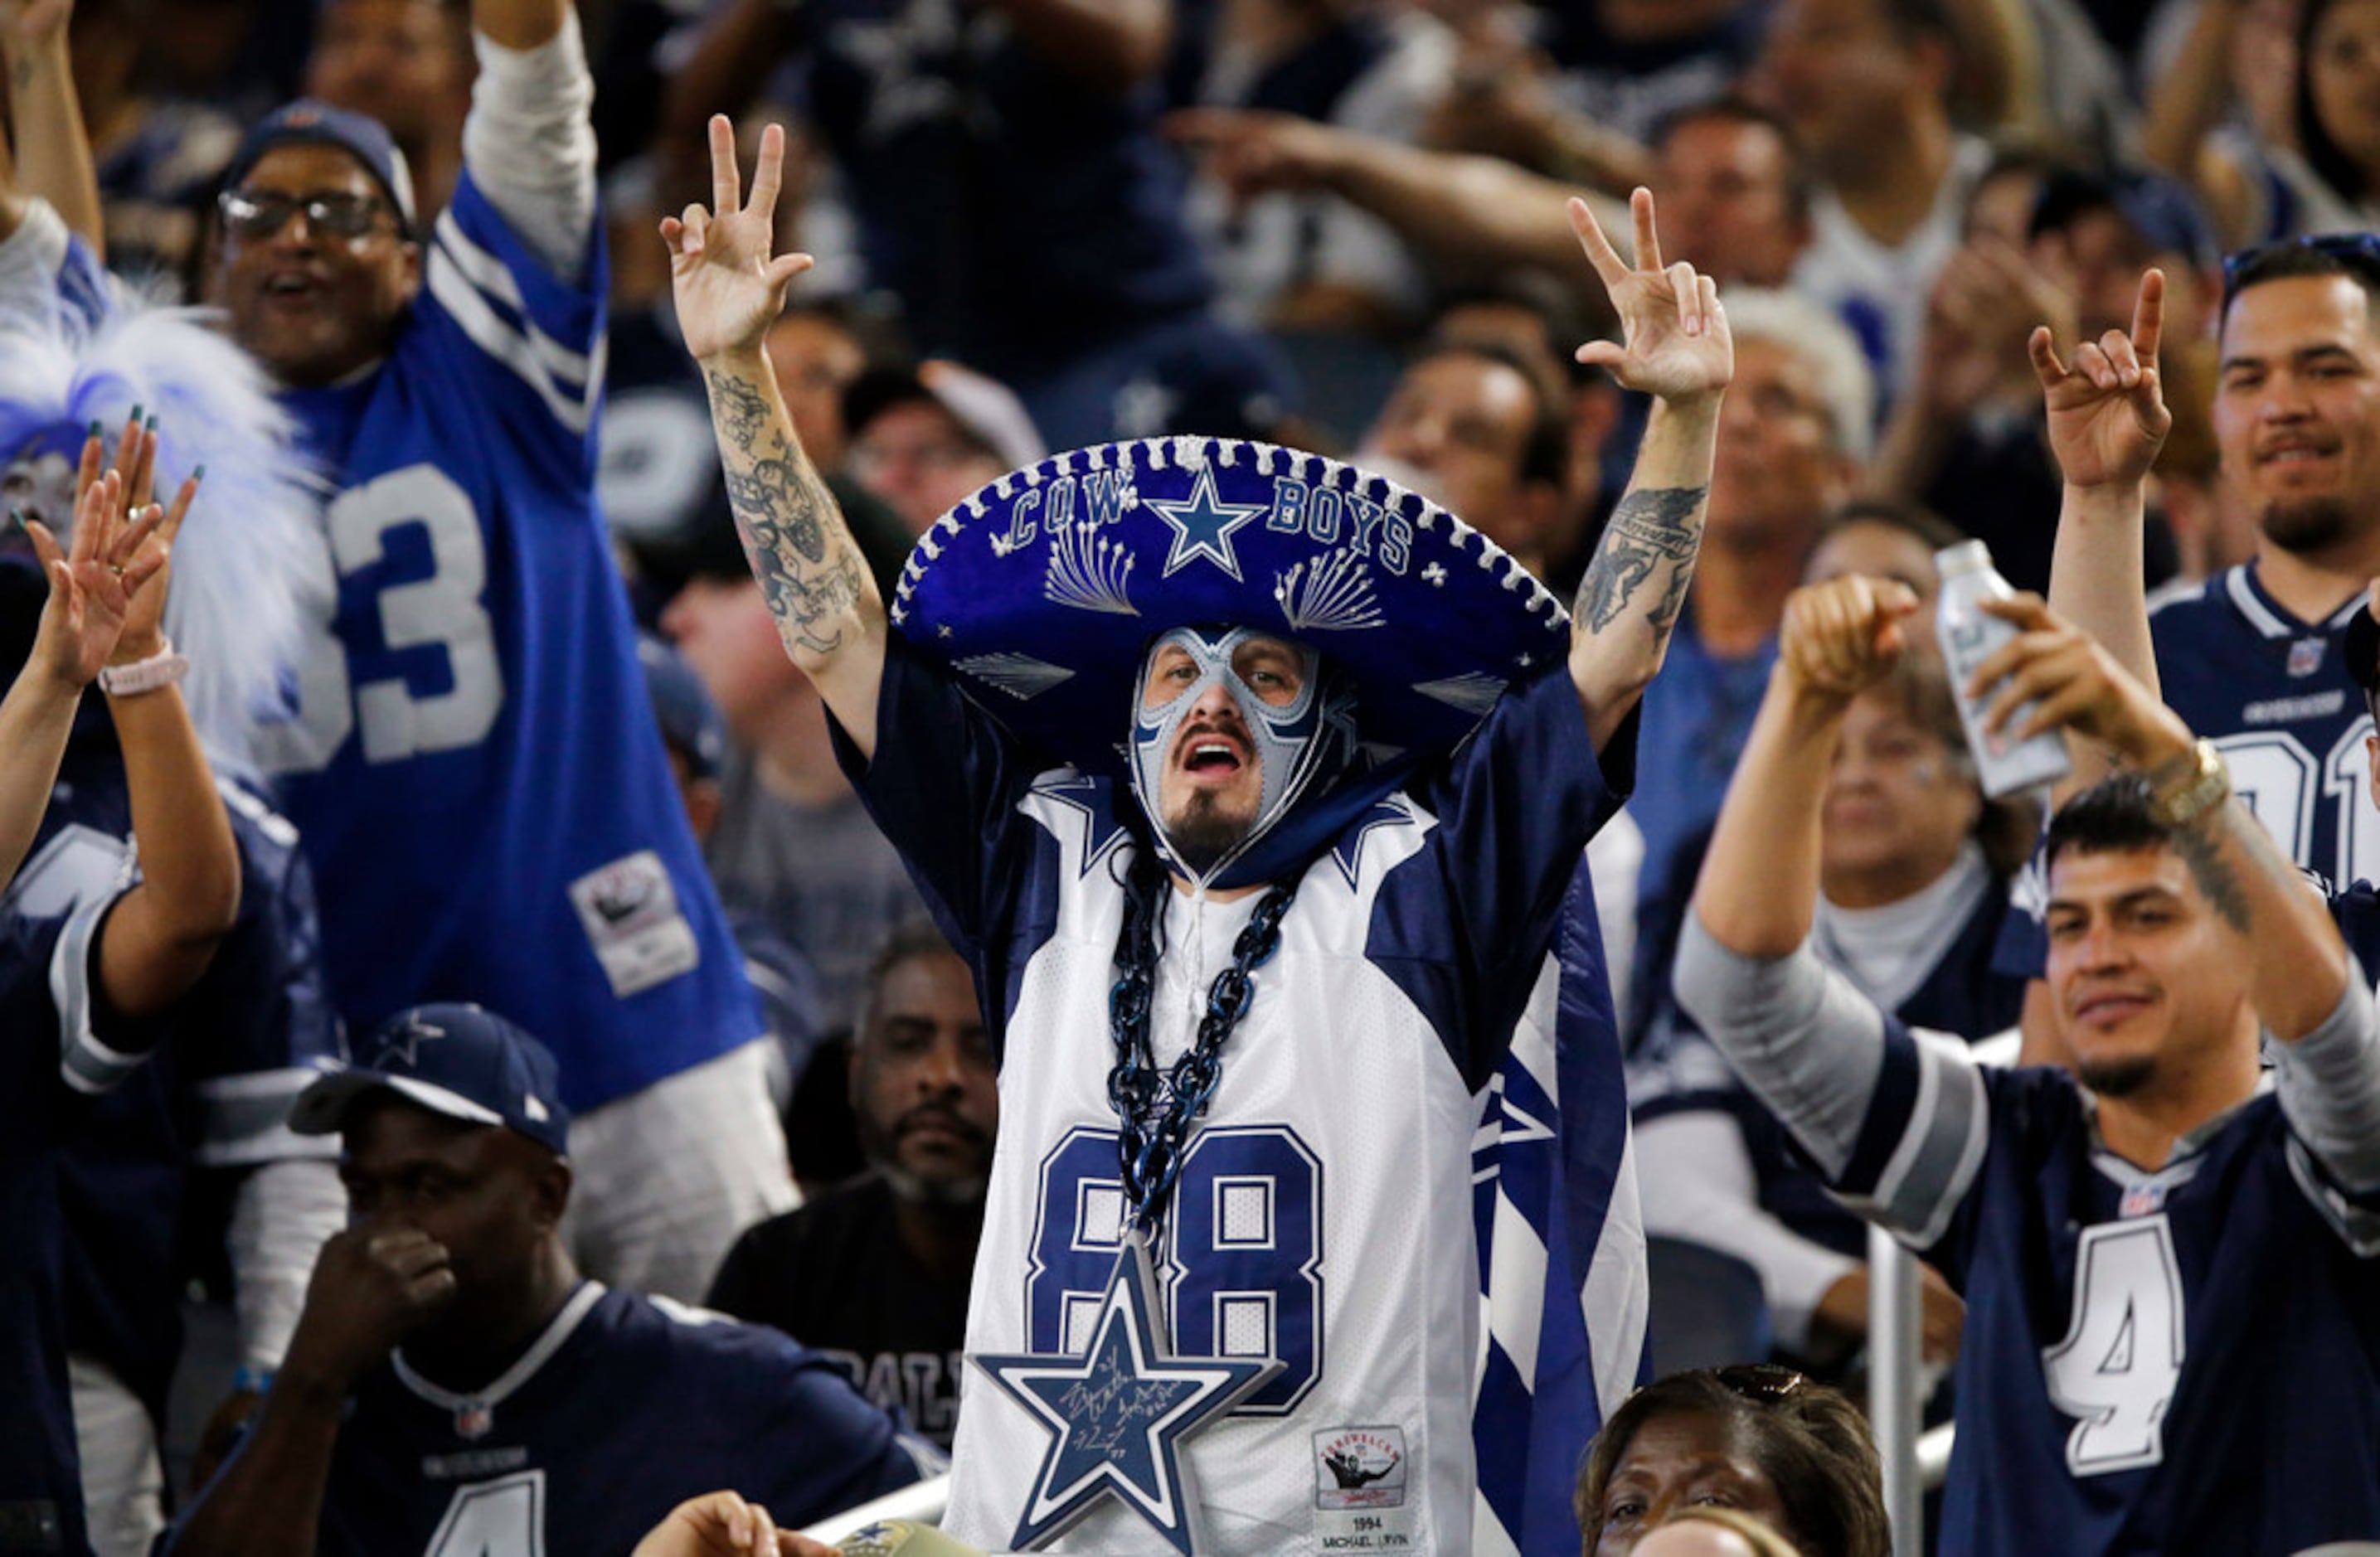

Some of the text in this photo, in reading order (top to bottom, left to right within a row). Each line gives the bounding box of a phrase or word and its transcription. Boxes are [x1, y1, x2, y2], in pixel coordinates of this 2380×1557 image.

[1009, 468, 1414, 576] COW BOYS
[1024, 1123, 1324, 1417] 88
[2041, 1211, 2186, 1477] 4
[1353, 1516, 1382, 1531] 1994
